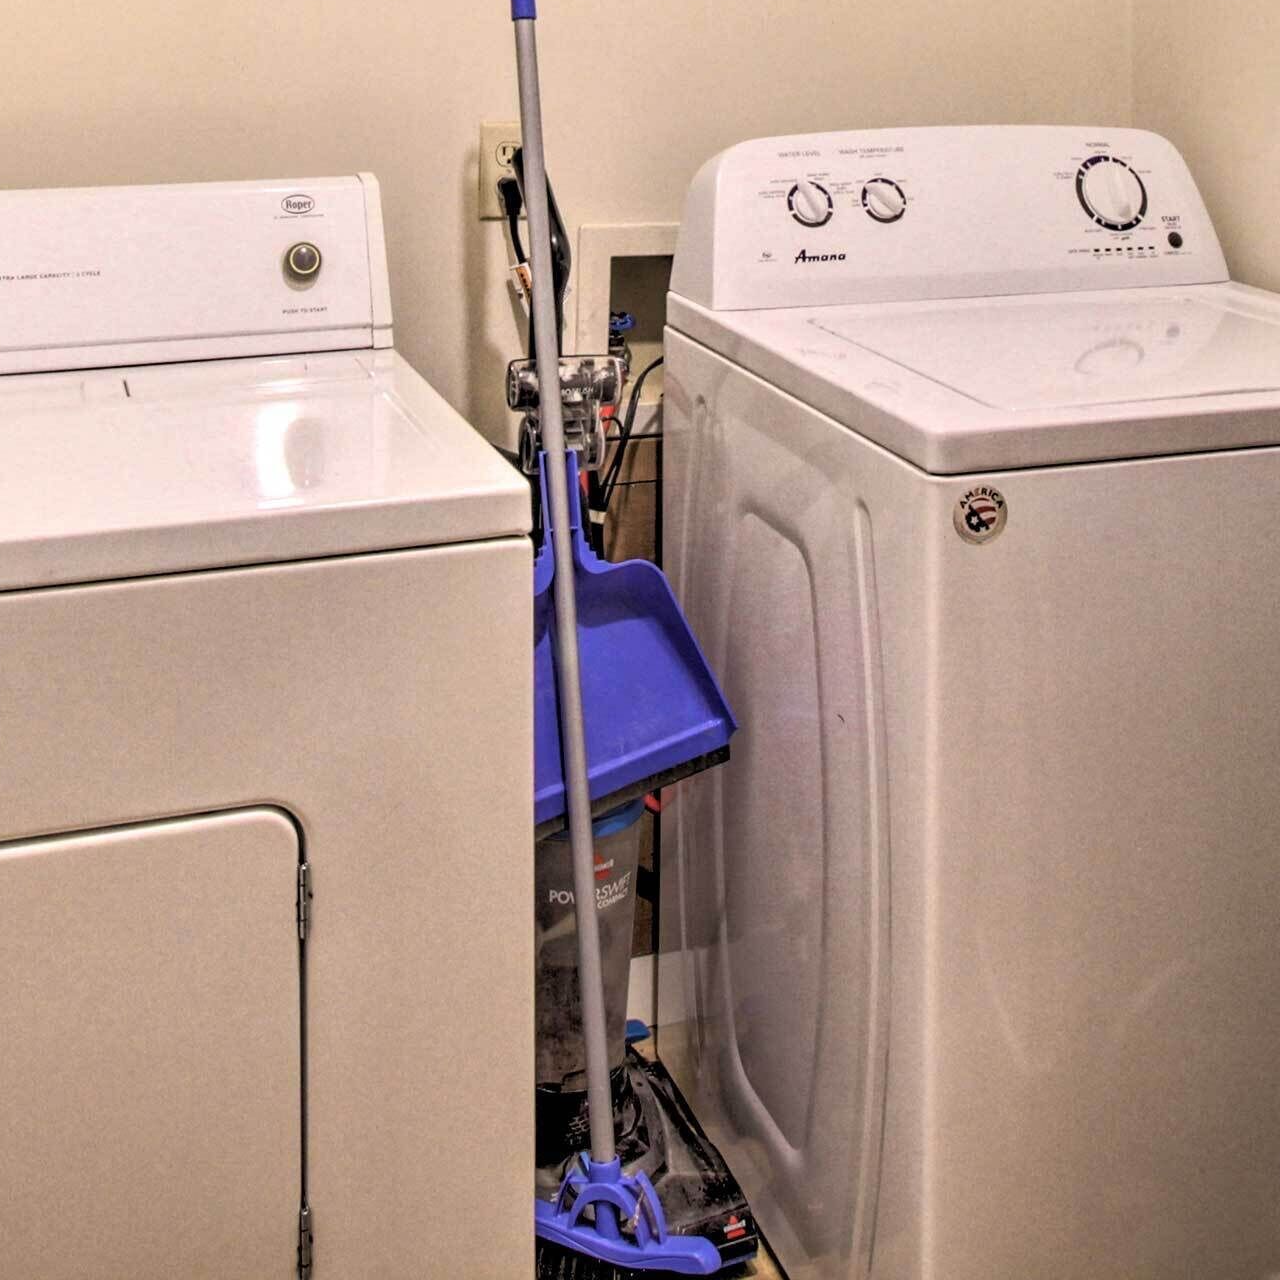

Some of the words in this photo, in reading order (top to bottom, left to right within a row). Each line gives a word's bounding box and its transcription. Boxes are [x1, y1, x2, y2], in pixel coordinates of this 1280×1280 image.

[285, 200, 312, 210] Roper
[794, 249, 846, 264] Amana
[959, 487, 1004, 509] AMERICA
